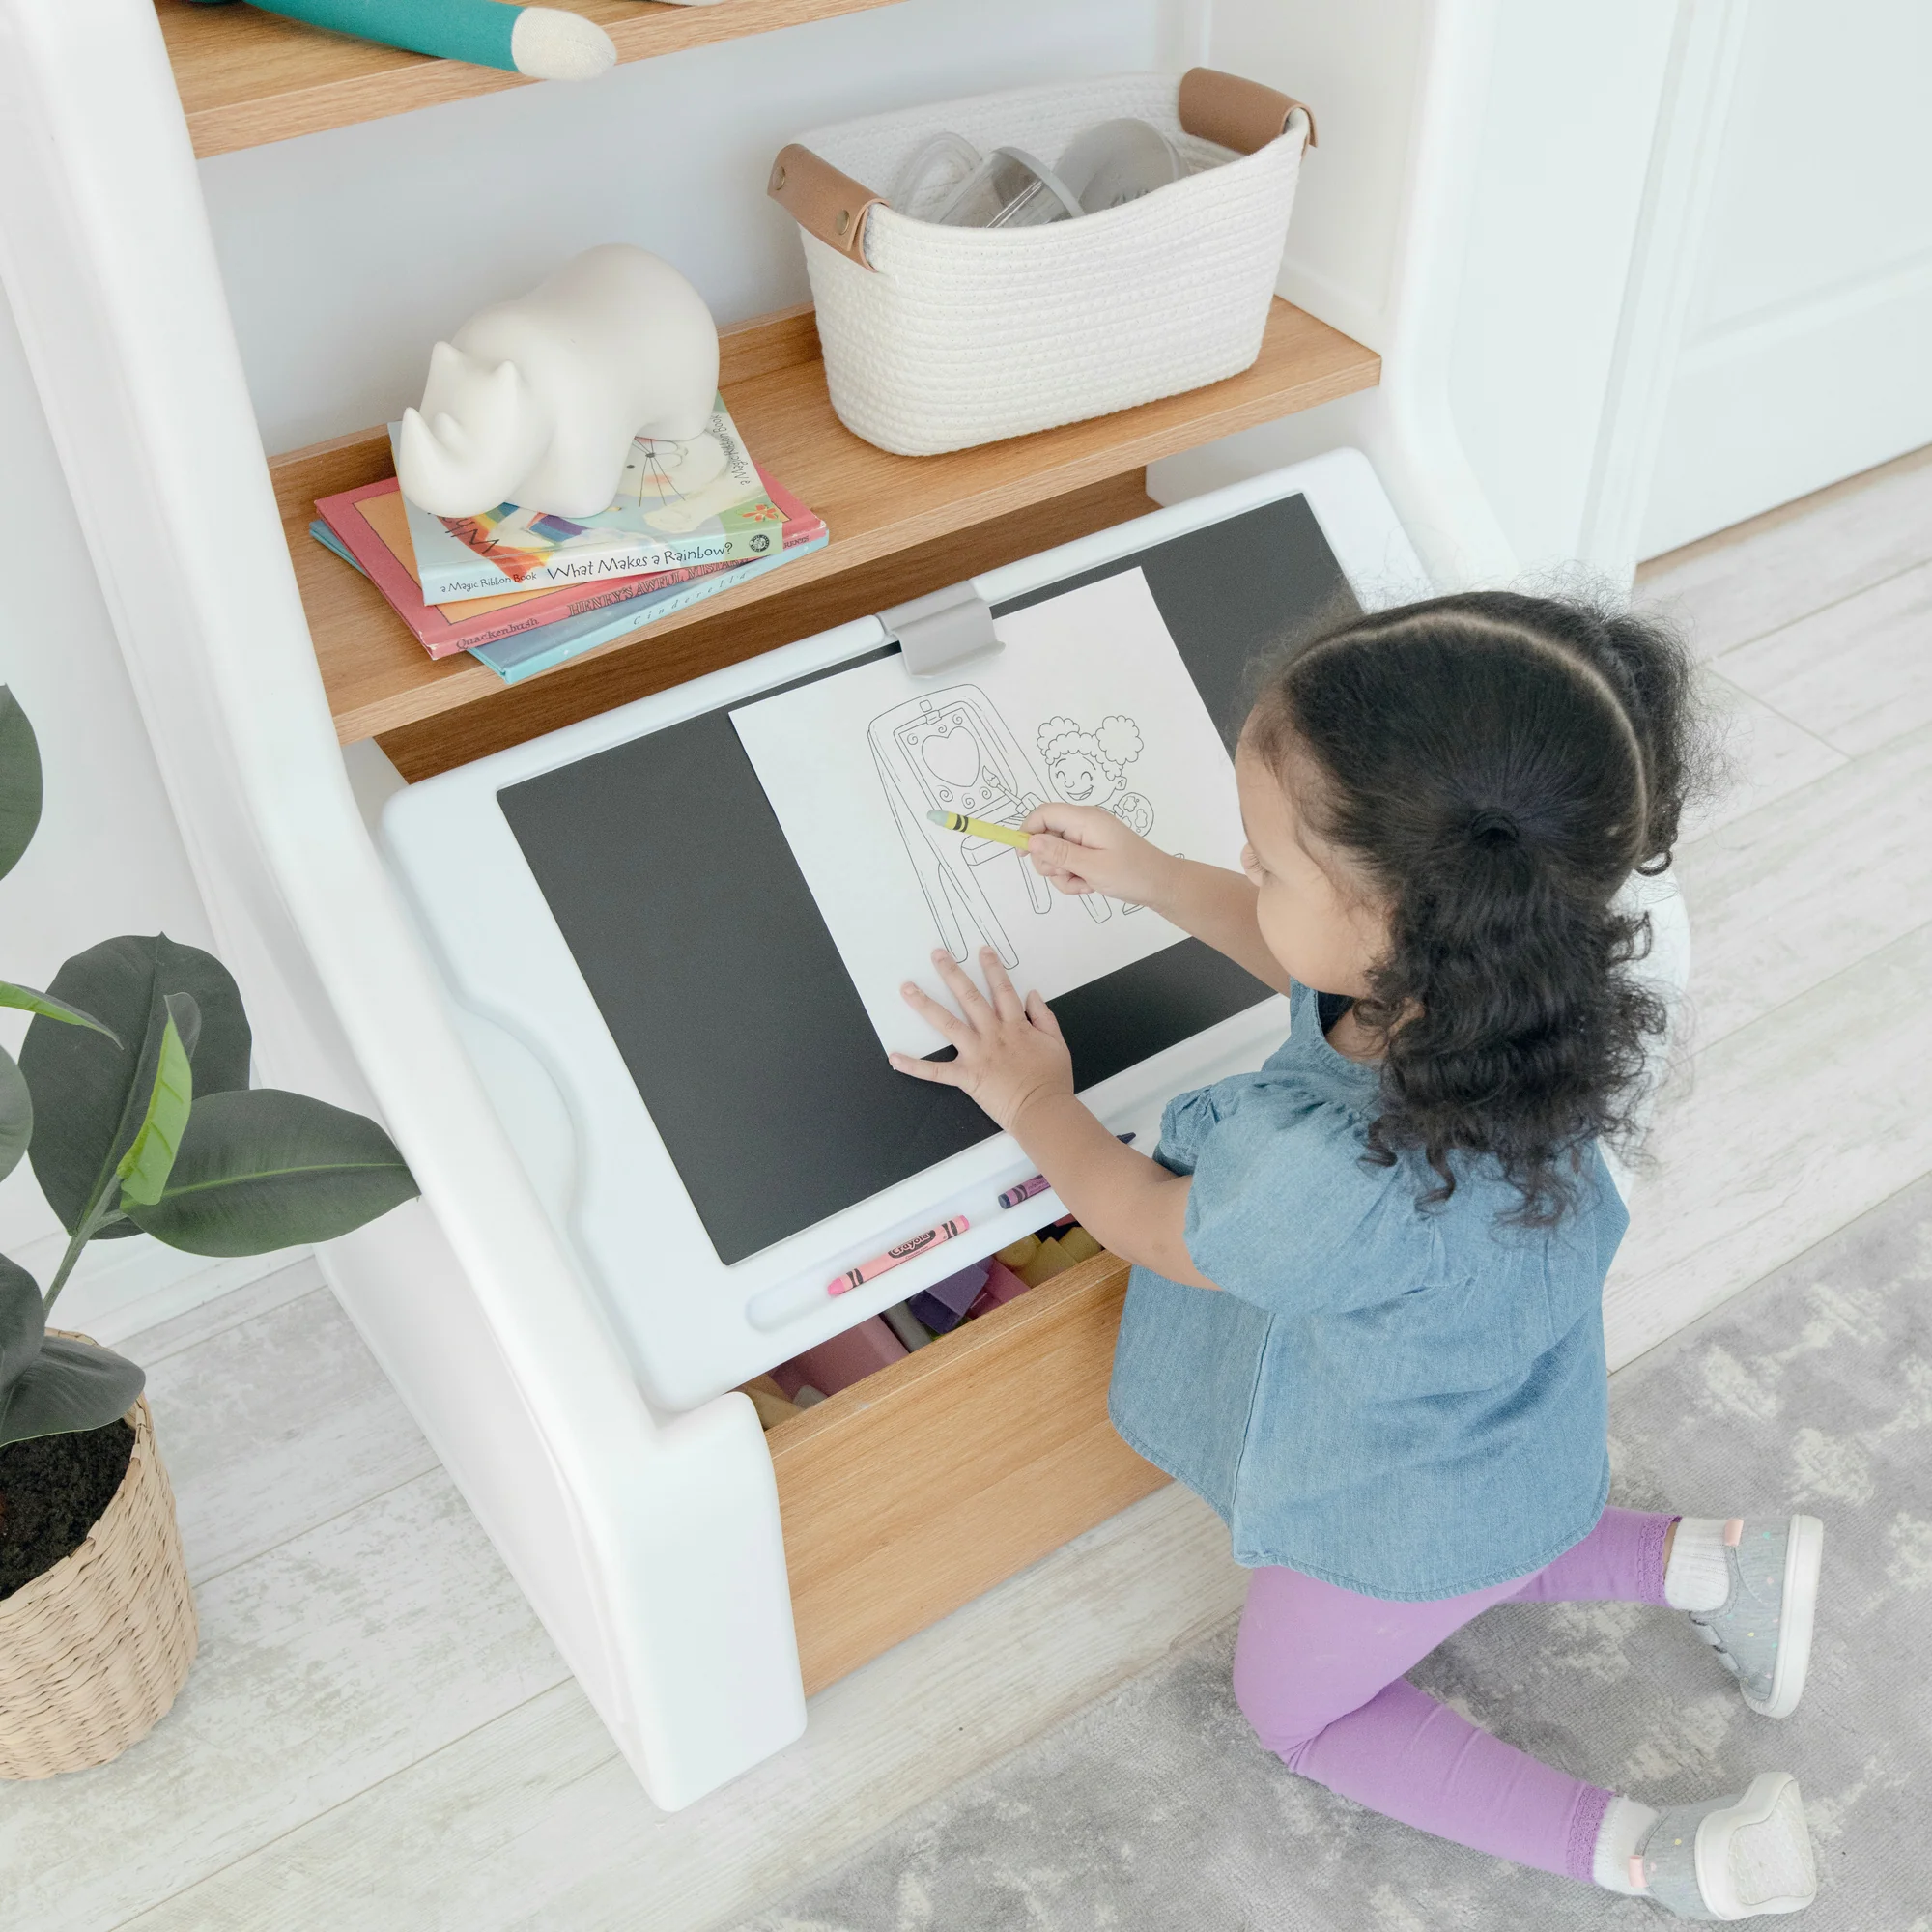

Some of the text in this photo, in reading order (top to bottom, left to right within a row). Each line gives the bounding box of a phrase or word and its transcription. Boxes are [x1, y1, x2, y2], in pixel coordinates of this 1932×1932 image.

[448, 582, 478, 594] Magic
[480, 576, 512, 588] Ribbon
[513, 572, 537, 582] Book
[547, 561, 594, 580] What
[597, 555, 648, 574] Makes
[653, 554, 660, 565] a
[663, 542, 733, 565] Rainbow?
[456, 617, 539, 651] Quackenbush
[567, 586, 633, 617] HENRY'S
[636, 572, 685, 597] AWFUL
[891, 1232, 932, 1256] Crayola
